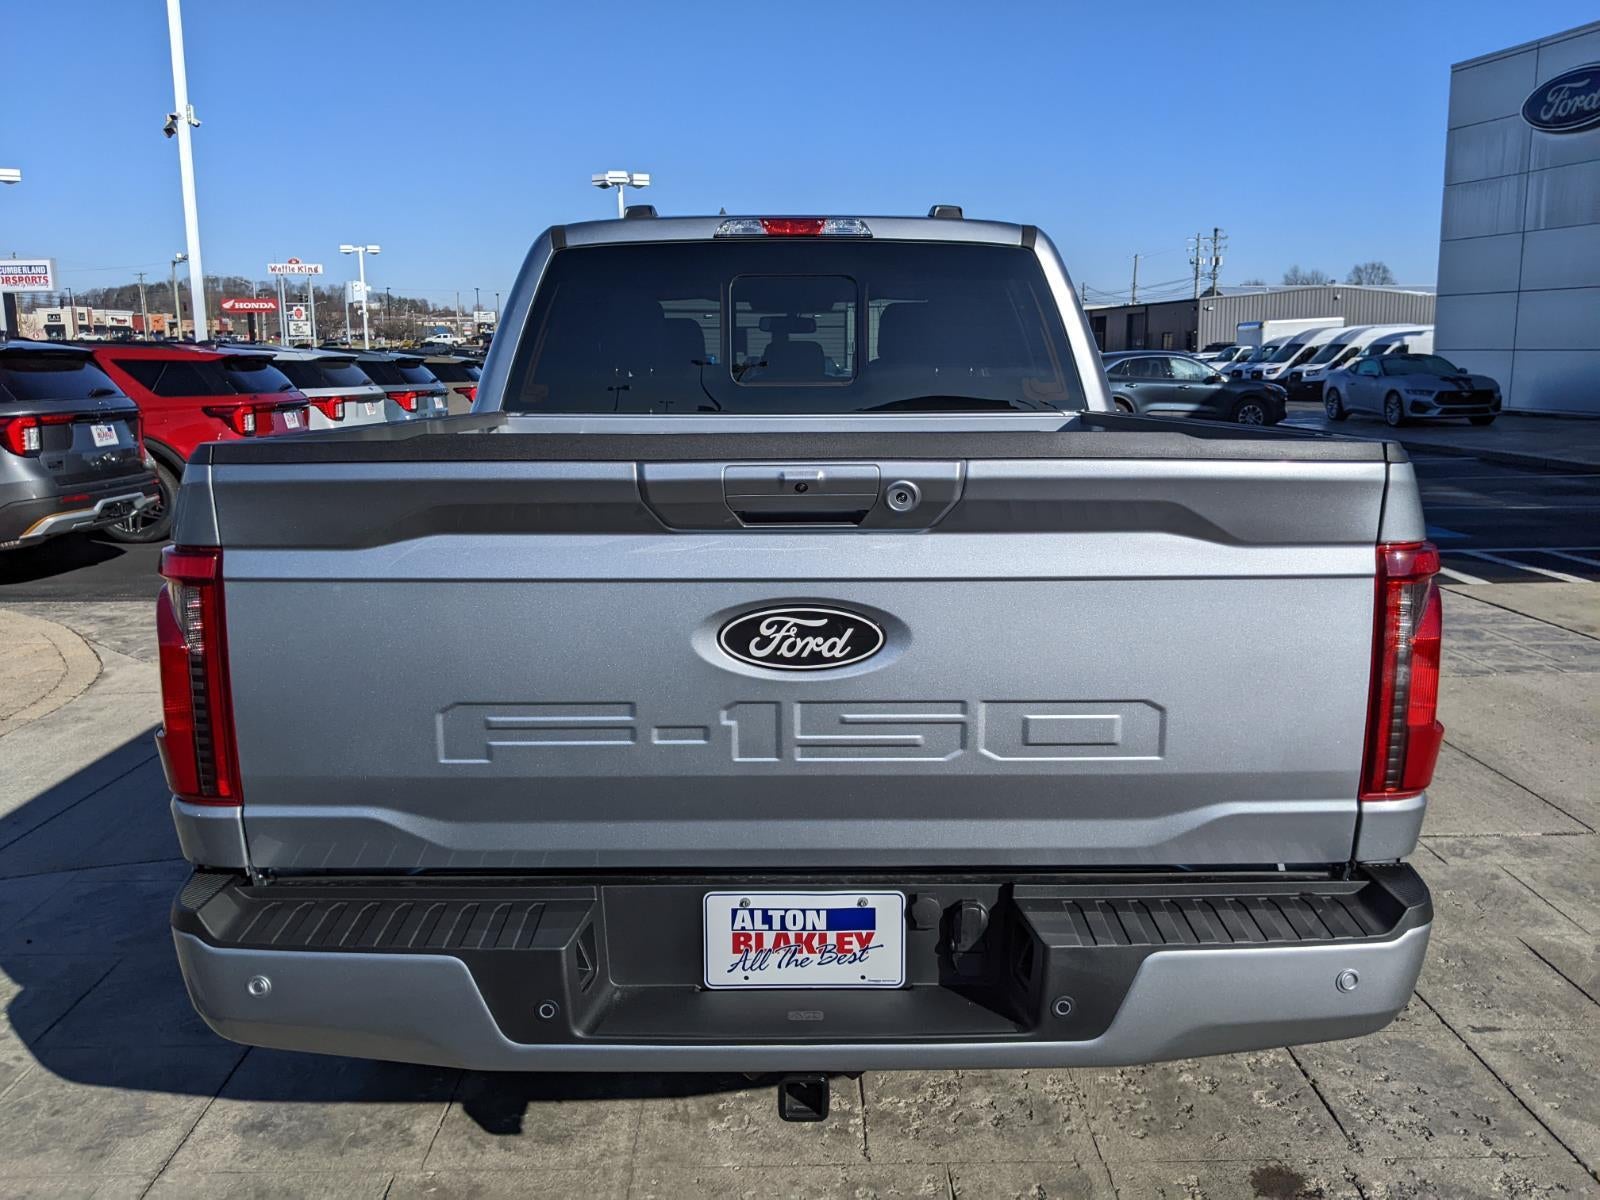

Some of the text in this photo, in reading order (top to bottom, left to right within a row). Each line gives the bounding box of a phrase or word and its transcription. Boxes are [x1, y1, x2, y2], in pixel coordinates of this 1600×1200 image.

[1541, 78, 1600, 120] Ford
[270, 265, 319, 273] Waffle King
[749, 616, 854, 658] Ford
[436, 700, 1166, 763] F-150
[733, 909, 827, 930] ALTON
[727, 943, 884, 974] All The Best
[731, 931, 876, 955] BLAKLEY
